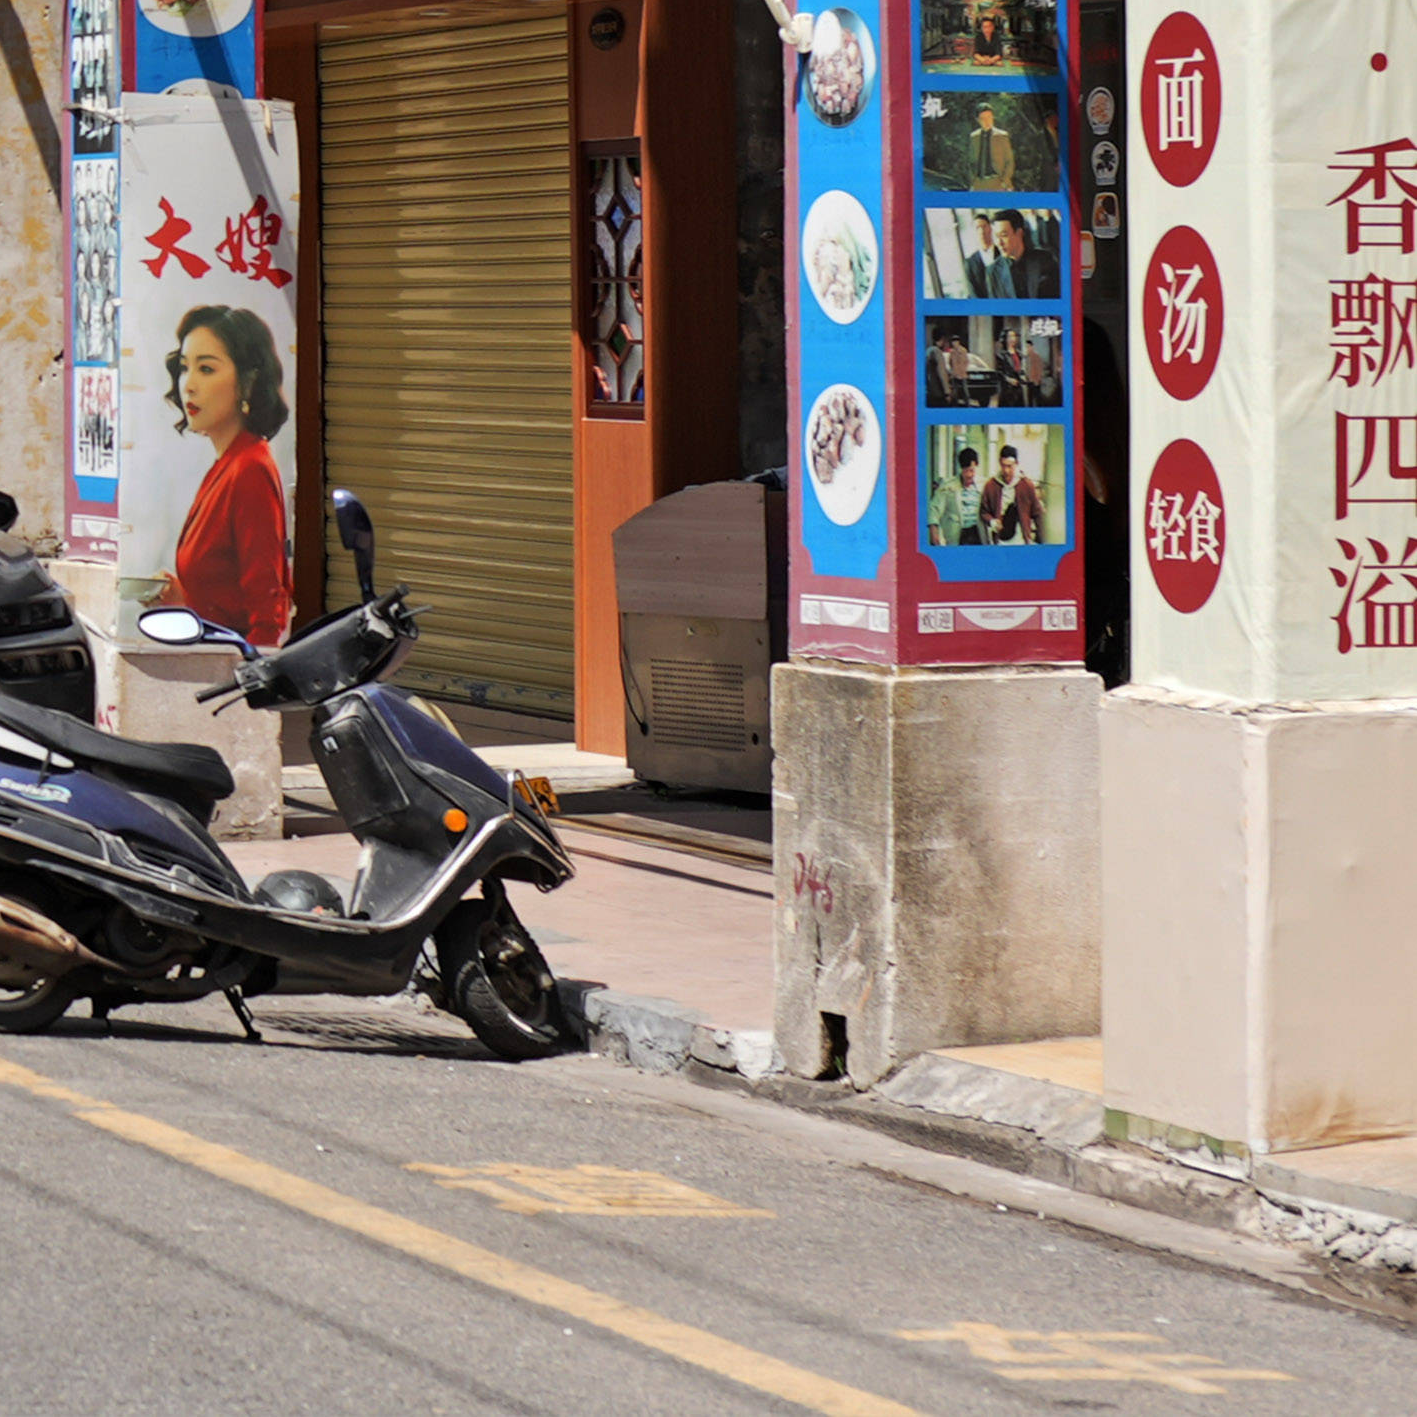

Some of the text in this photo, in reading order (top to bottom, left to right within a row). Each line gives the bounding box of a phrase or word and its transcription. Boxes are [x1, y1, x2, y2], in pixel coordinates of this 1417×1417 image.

[1154, 48, 1206, 154] 面
[139, 194, 293, 289] 大嫂
[1158, 262, 1209, 368] 汤
[1148, 488, 1222, 566] 轻食
